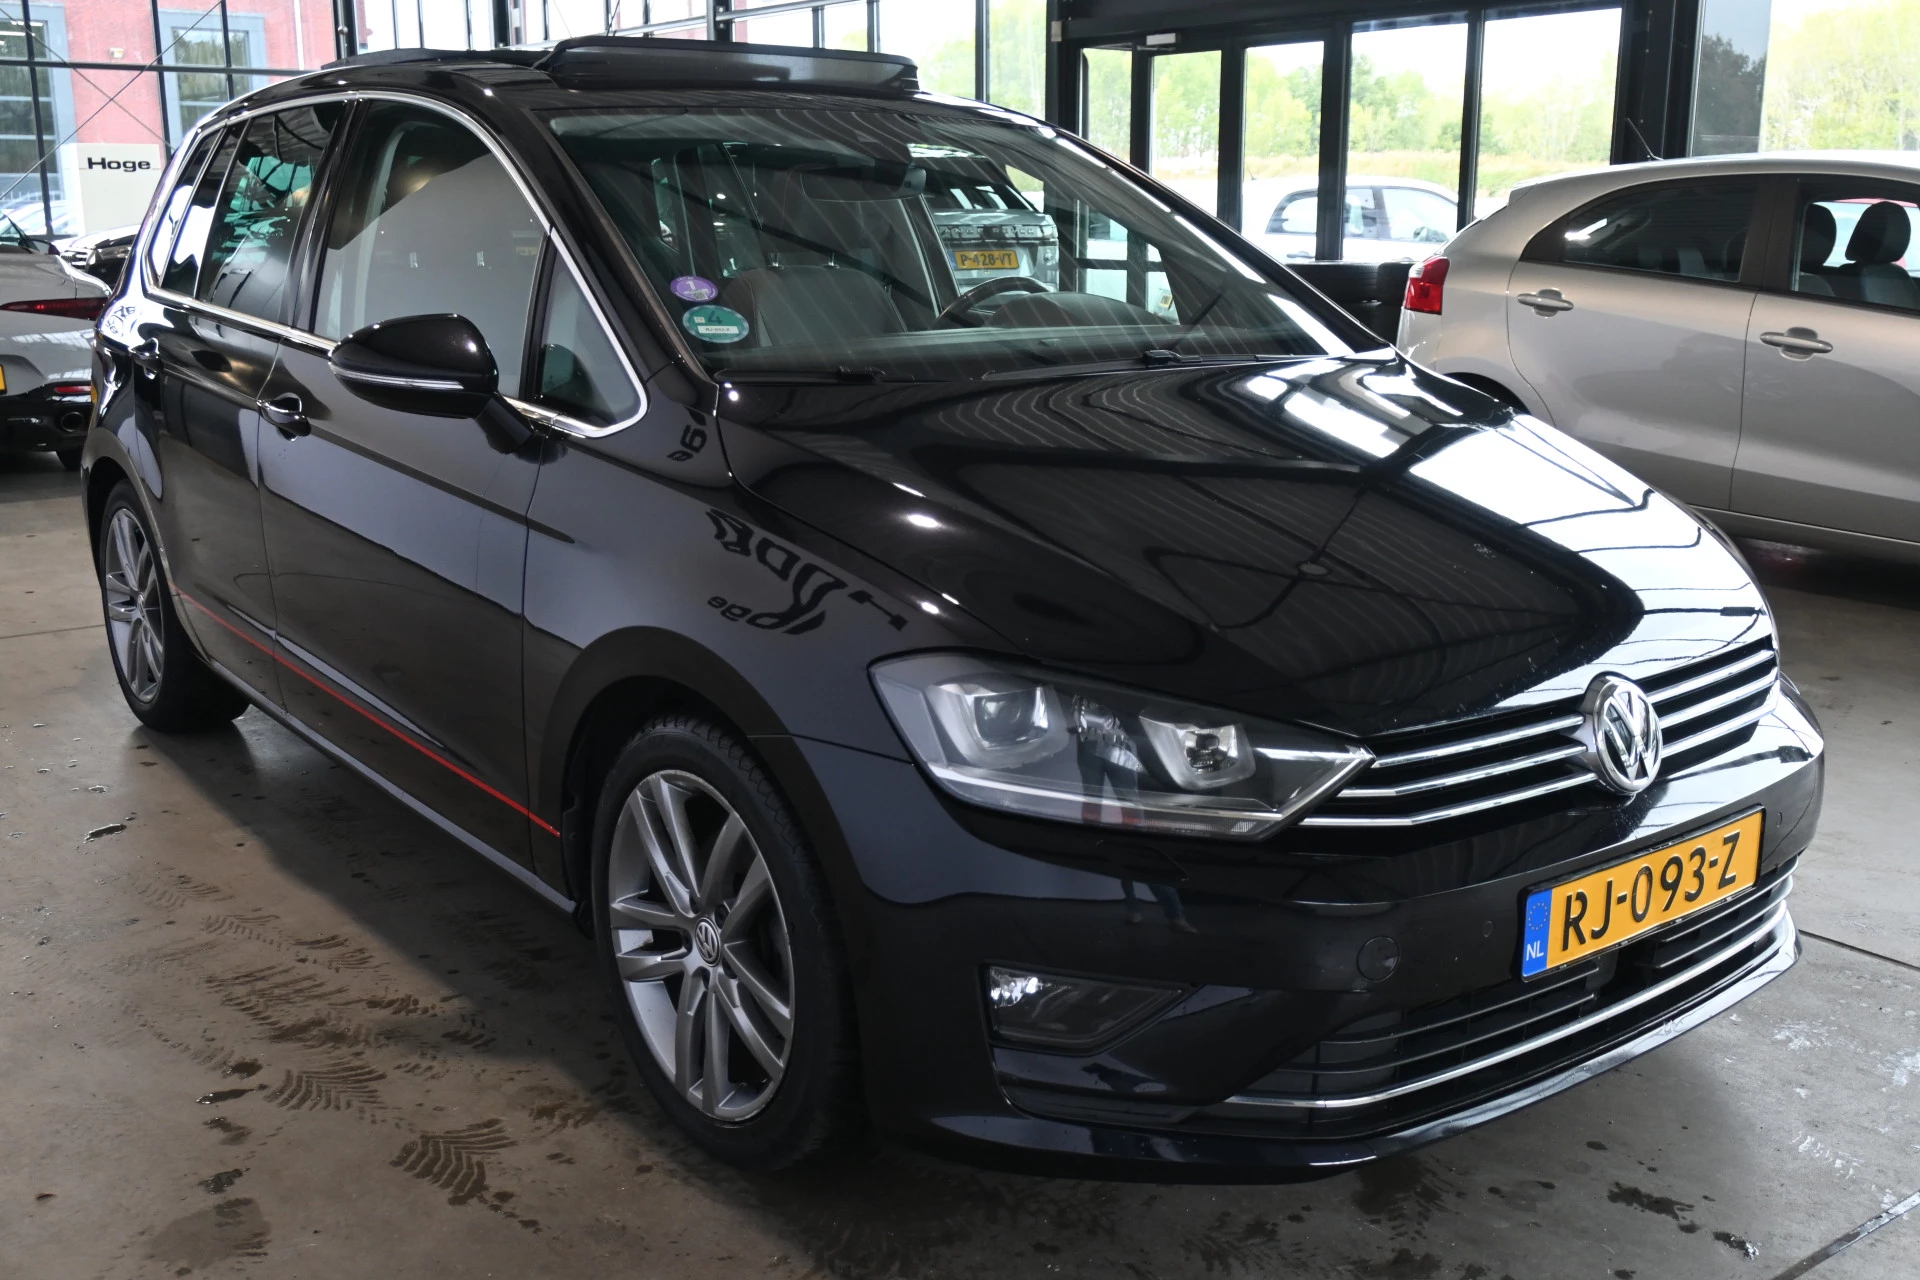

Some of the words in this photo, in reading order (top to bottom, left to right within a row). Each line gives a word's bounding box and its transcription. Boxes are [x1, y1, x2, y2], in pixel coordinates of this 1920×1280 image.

[87, 157, 151, 172] Hoge
[960, 253, 1013, 266] P-428-VT
[686, 280, 696, 291] 1
[707, 311, 723, 324] 4
[1562, 831, 1741, 952] RJ-093-Z
[1526, 942, 1545, 961] NL
